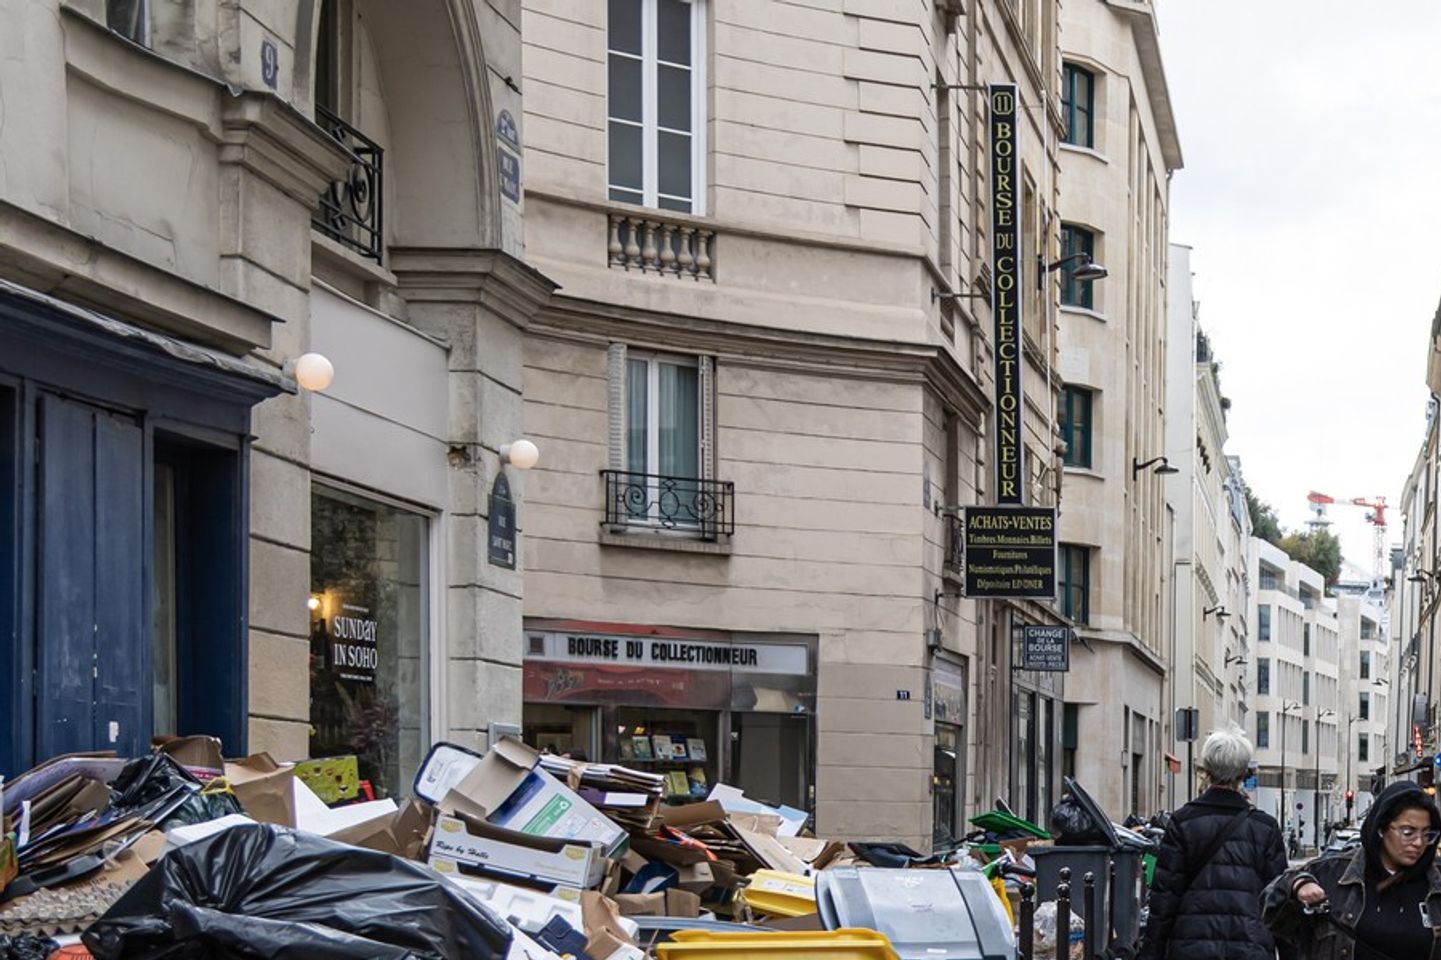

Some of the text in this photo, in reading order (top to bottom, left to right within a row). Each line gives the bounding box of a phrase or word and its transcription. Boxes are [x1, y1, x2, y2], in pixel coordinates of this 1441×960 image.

[265, 45, 274, 79] 9
[995, 122, 1017, 497] BOURSE DU COLLECTIONNEUR
[969, 515, 1052, 530] ACHATS-VENTES
[1028, 629, 1063, 638] CHANGE
[334, 644, 378, 669] IN SOHO
[567, 637, 757, 666] BOURSE DU COLLECTIONNEUR
[1028, 644, 1063, 652] BOURSE
